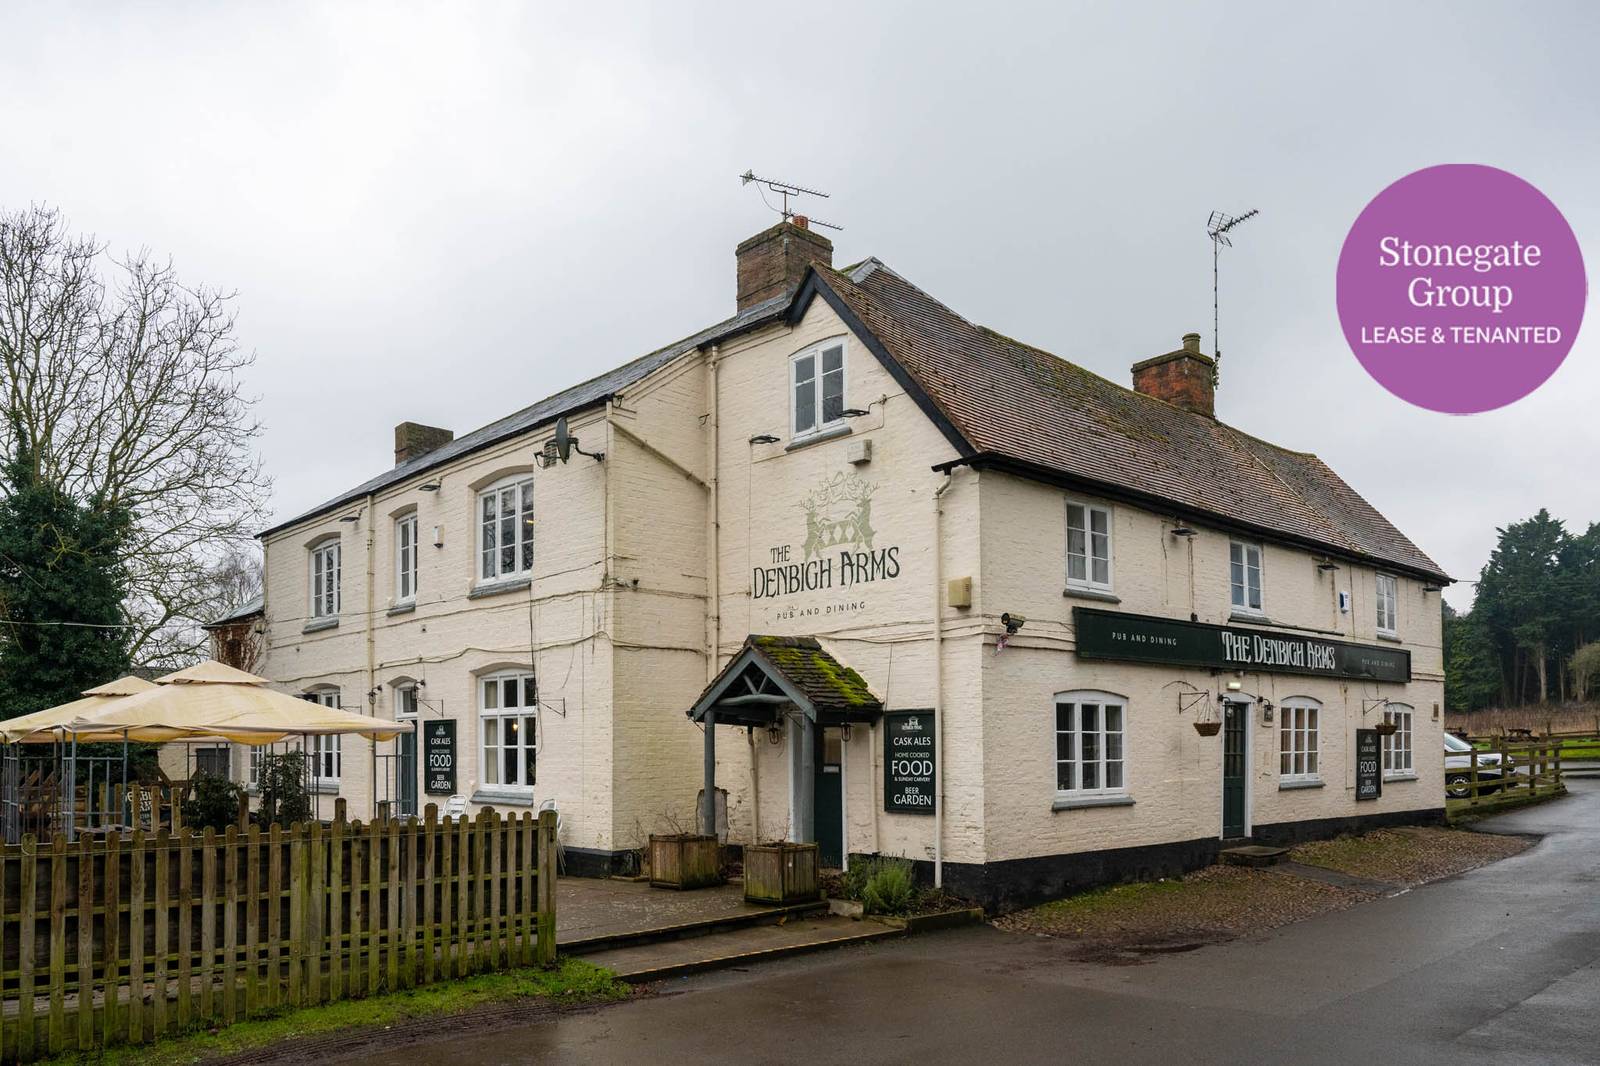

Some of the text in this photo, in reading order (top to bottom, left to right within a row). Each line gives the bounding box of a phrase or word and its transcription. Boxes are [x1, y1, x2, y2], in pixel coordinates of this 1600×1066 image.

[770, 544, 791, 564] THE
[753, 546, 900, 599] DENBIGH ARMS
[776, 601, 866, 621] PUB AND DINING
[1112, 631, 1177, 646] PUB AND DINING
[1221, 631, 1336, 670] THE DENBIGH ARMS
[430, 737, 451, 745] CASK ALES
[893, 737, 931, 746] CASK ALES
[429, 754, 452, 767] FOOD
[1360, 761, 1377, 773] FOOD
[891, 760, 933, 776] FOOD
[430, 780, 452, 789] GARDEN
[893, 794, 932, 805] GARDEN
